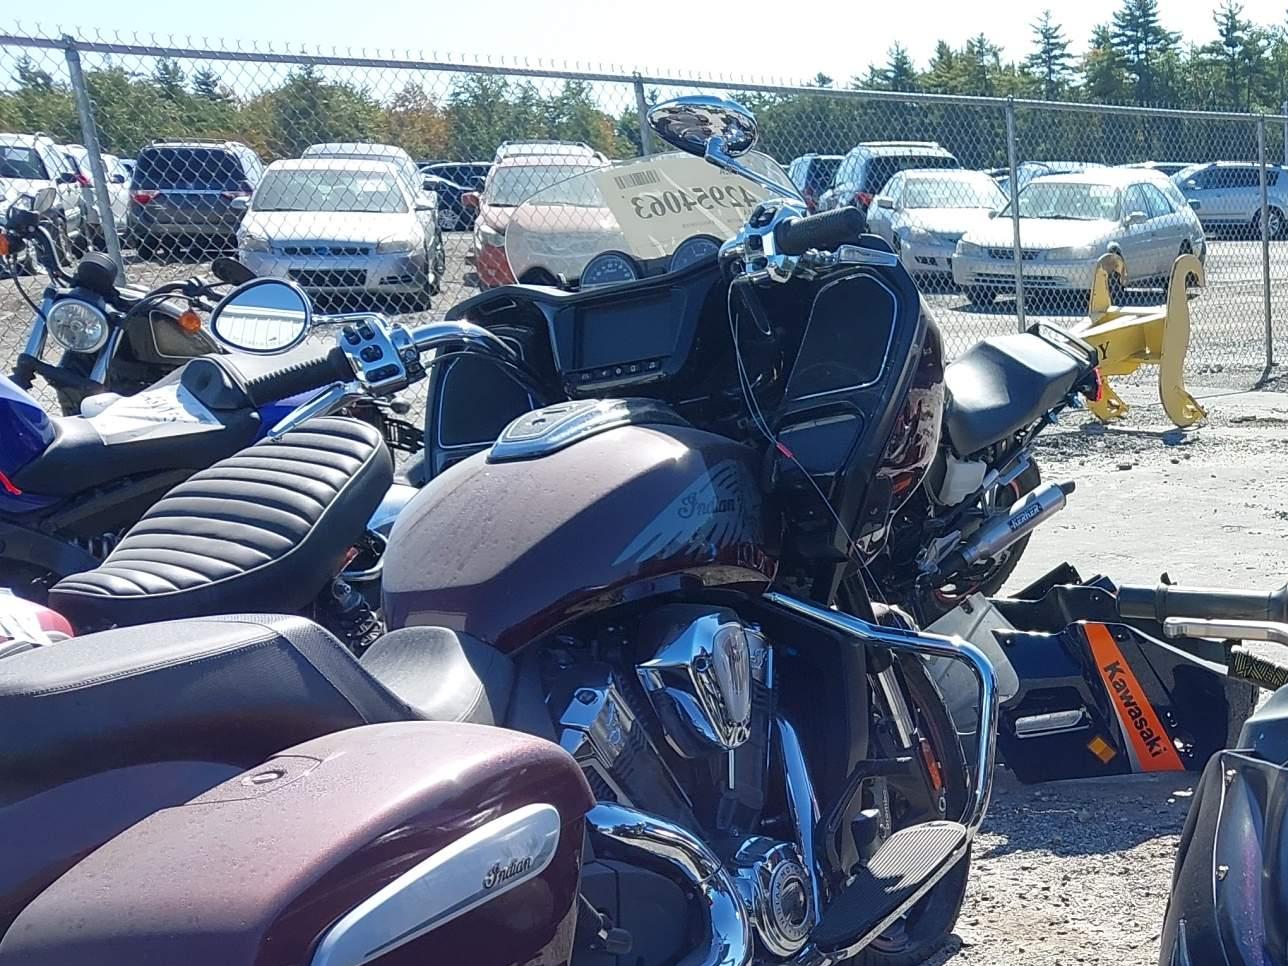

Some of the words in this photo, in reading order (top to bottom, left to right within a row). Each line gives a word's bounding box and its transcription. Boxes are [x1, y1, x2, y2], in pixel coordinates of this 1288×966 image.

[677, 491, 736, 519] Indian
[1102, 660, 1168, 759] Kawasaki
[482, 856, 532, 889] Indian
